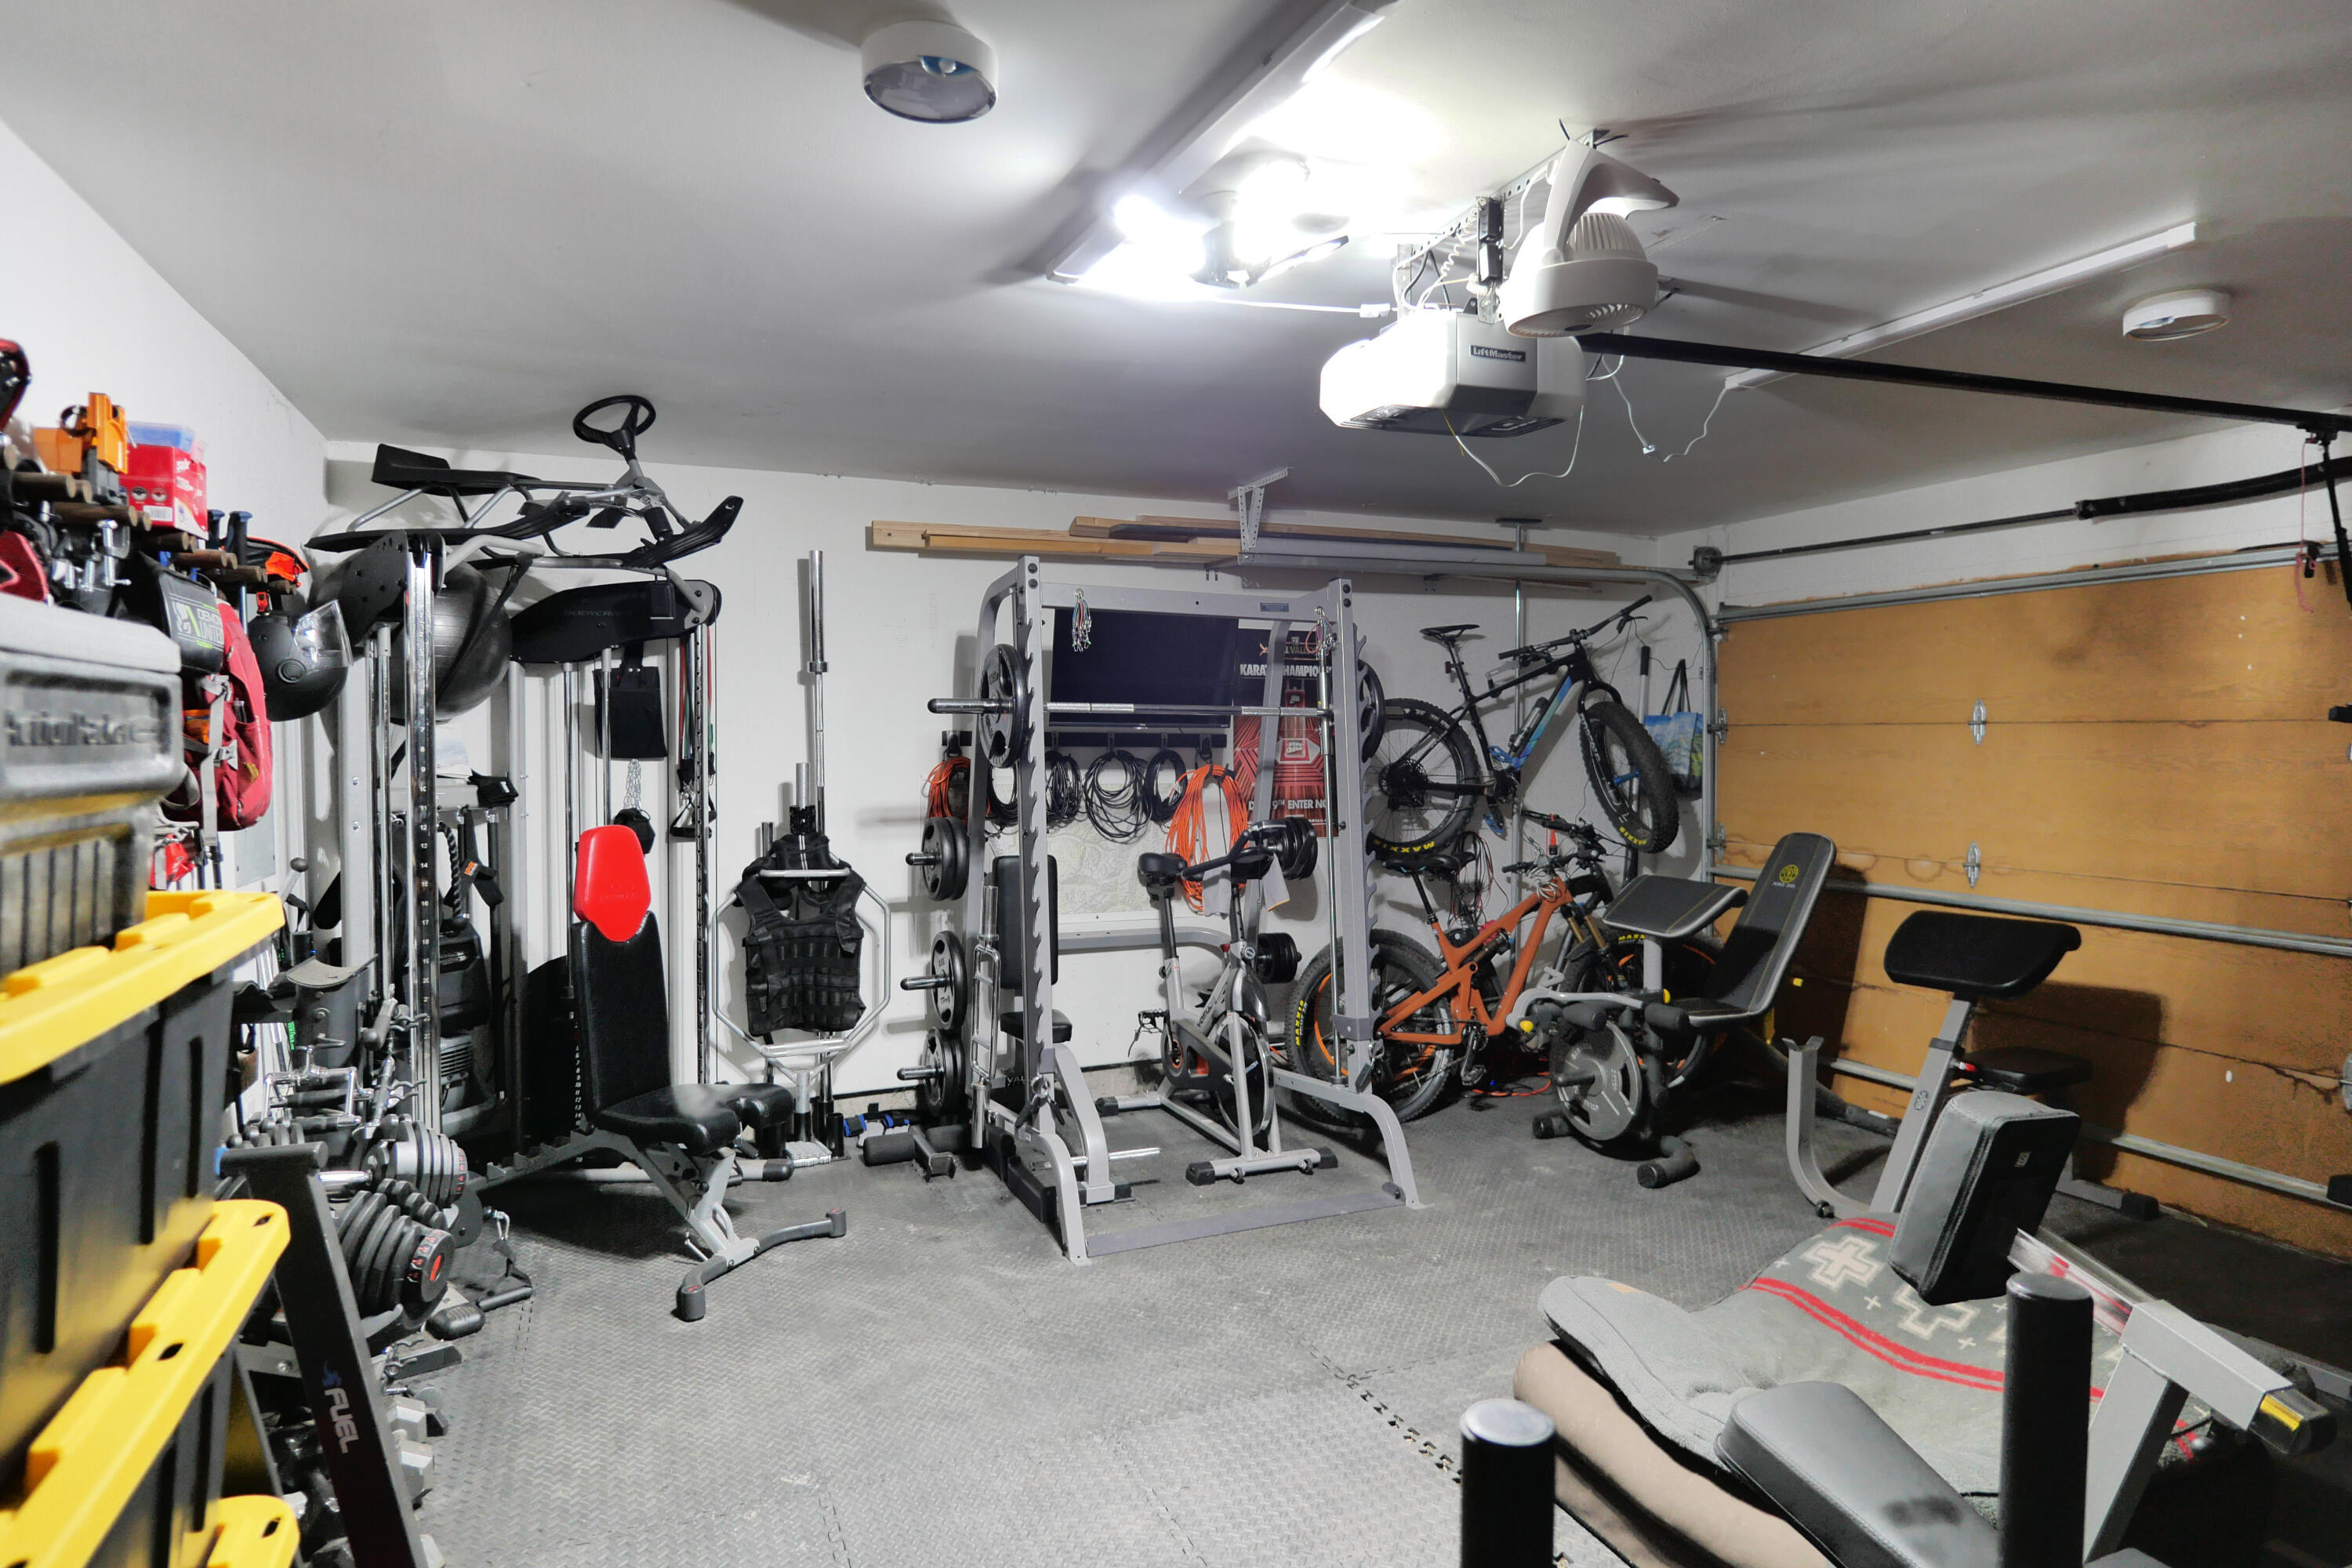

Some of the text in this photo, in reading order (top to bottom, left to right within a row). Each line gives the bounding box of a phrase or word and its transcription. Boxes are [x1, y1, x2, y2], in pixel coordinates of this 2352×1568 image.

[1473, 347, 1523, 360] LiftMaster
[1240, 664, 1267, 676] KARA
[1272, 798, 1326, 810] 9TH ENTER NO
[1619, 826, 1647, 846] MAXXIS
[1374, 840, 1435, 853] MAXXIS
[1295, 999, 1305, 1046] MAXXIS
[325, 1388, 359, 1454] FUEL
